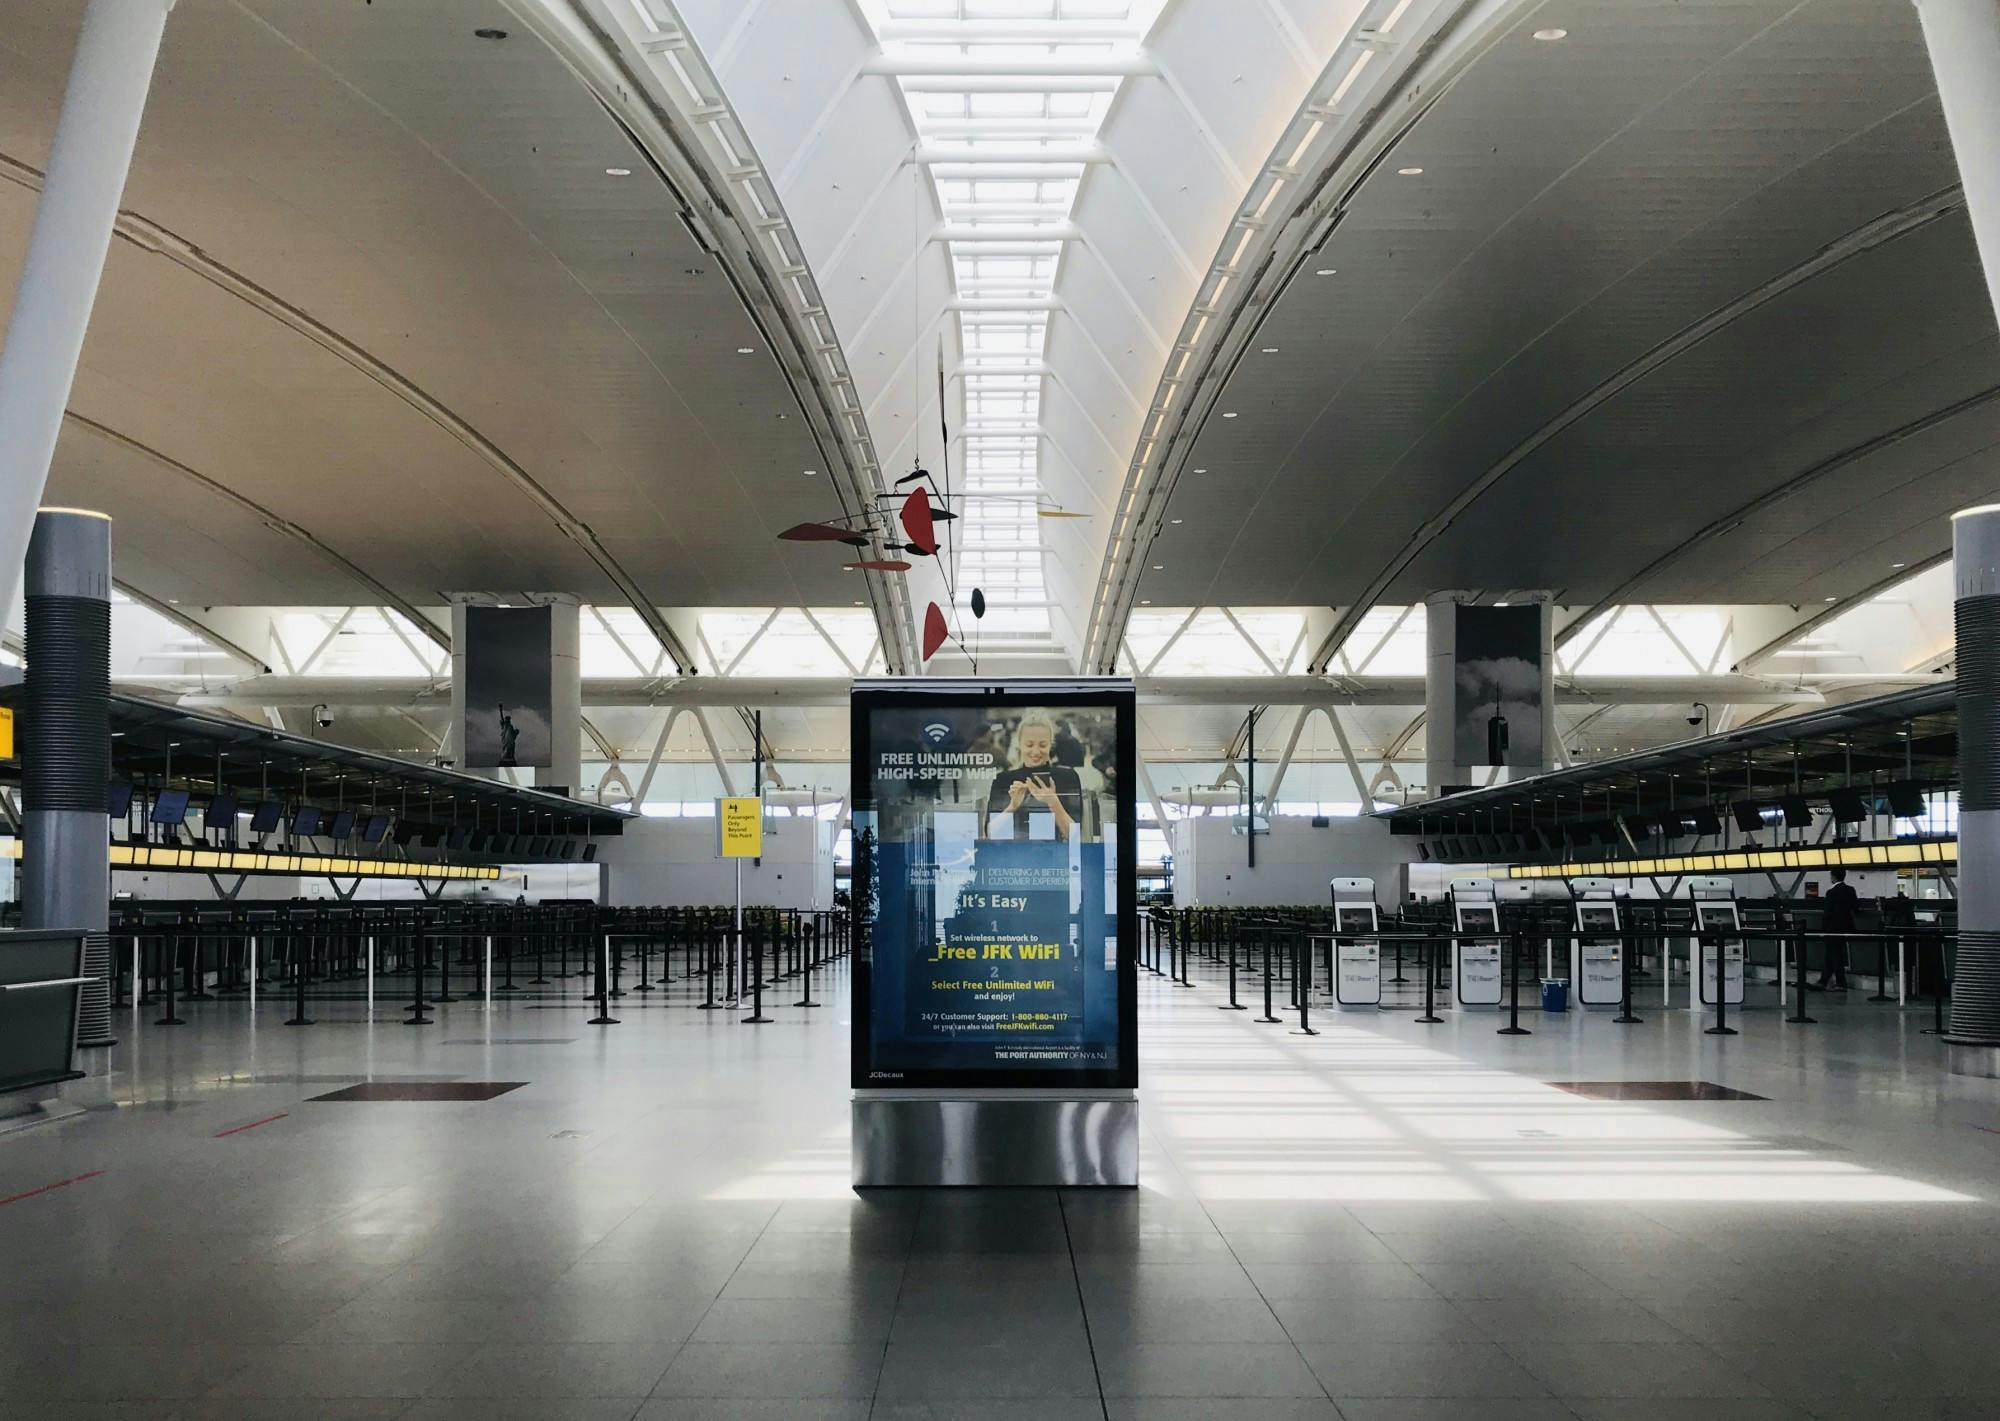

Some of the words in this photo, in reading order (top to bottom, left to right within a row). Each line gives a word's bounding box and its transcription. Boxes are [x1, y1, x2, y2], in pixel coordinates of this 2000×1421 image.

[881, 753, 913, 765] FREE
[917, 753, 994, 765] UNLIMITED
[877, 768, 962, 780] HIGH-SPEED
[988, 877, 1031, 885] CUSTOMER
[991, 894, 1028, 912] Easy
[991, 920, 998, 932] 1
[950, 934, 962, 942] Set
[964, 934, 995, 942] wireless
[997, 934, 1029, 942] network
[1030, 934, 1038, 942] to
[982, 944, 1012, 959] JFK
[1018, 944, 1060, 959] WiFi
[990, 966, 999, 978] 2
[931, 980, 960, 990] Select
[963, 981, 983, 990] Free
[985, 980, 1031, 990] Unlimited
[1034, 980, 1055, 990] WiFi
[974, 992, 989, 1000] and
[991, 992, 1015, 1002] enjoy!
[977, 1013, 1008, 1022] Support:
[995, 1051, 1008, 1059] THE
[1009, 1051, 1029, 1059] PORT
[1029, 1051, 1068, 1059] AUTHORITY
[1069, 1051, 1080, 1059] OF
